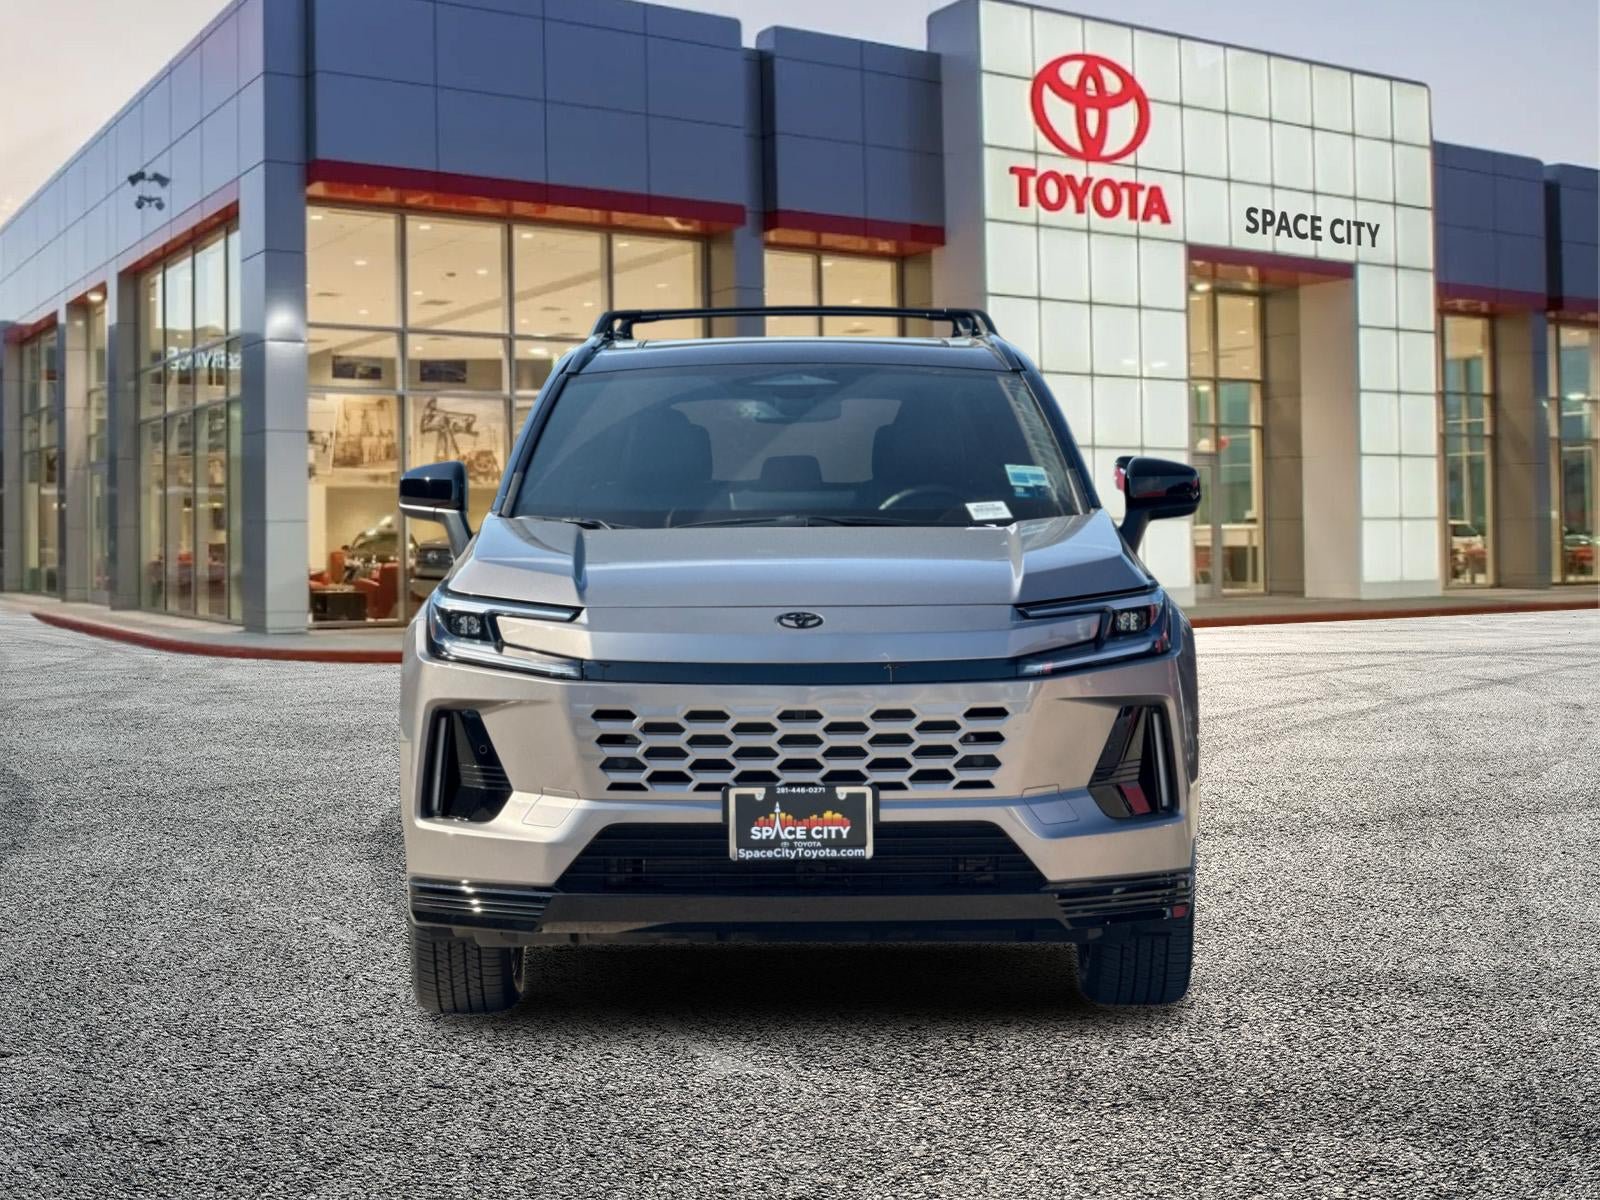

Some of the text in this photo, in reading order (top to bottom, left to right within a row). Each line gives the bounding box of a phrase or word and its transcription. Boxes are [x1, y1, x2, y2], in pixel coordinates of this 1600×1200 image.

[1009, 165, 1171, 225] TOYOTA
[1245, 206, 1381, 248] SPACE CITY
[750, 824, 850, 840] SPACE CITY
[738, 847, 865, 860] SpaceCityToyota.com
